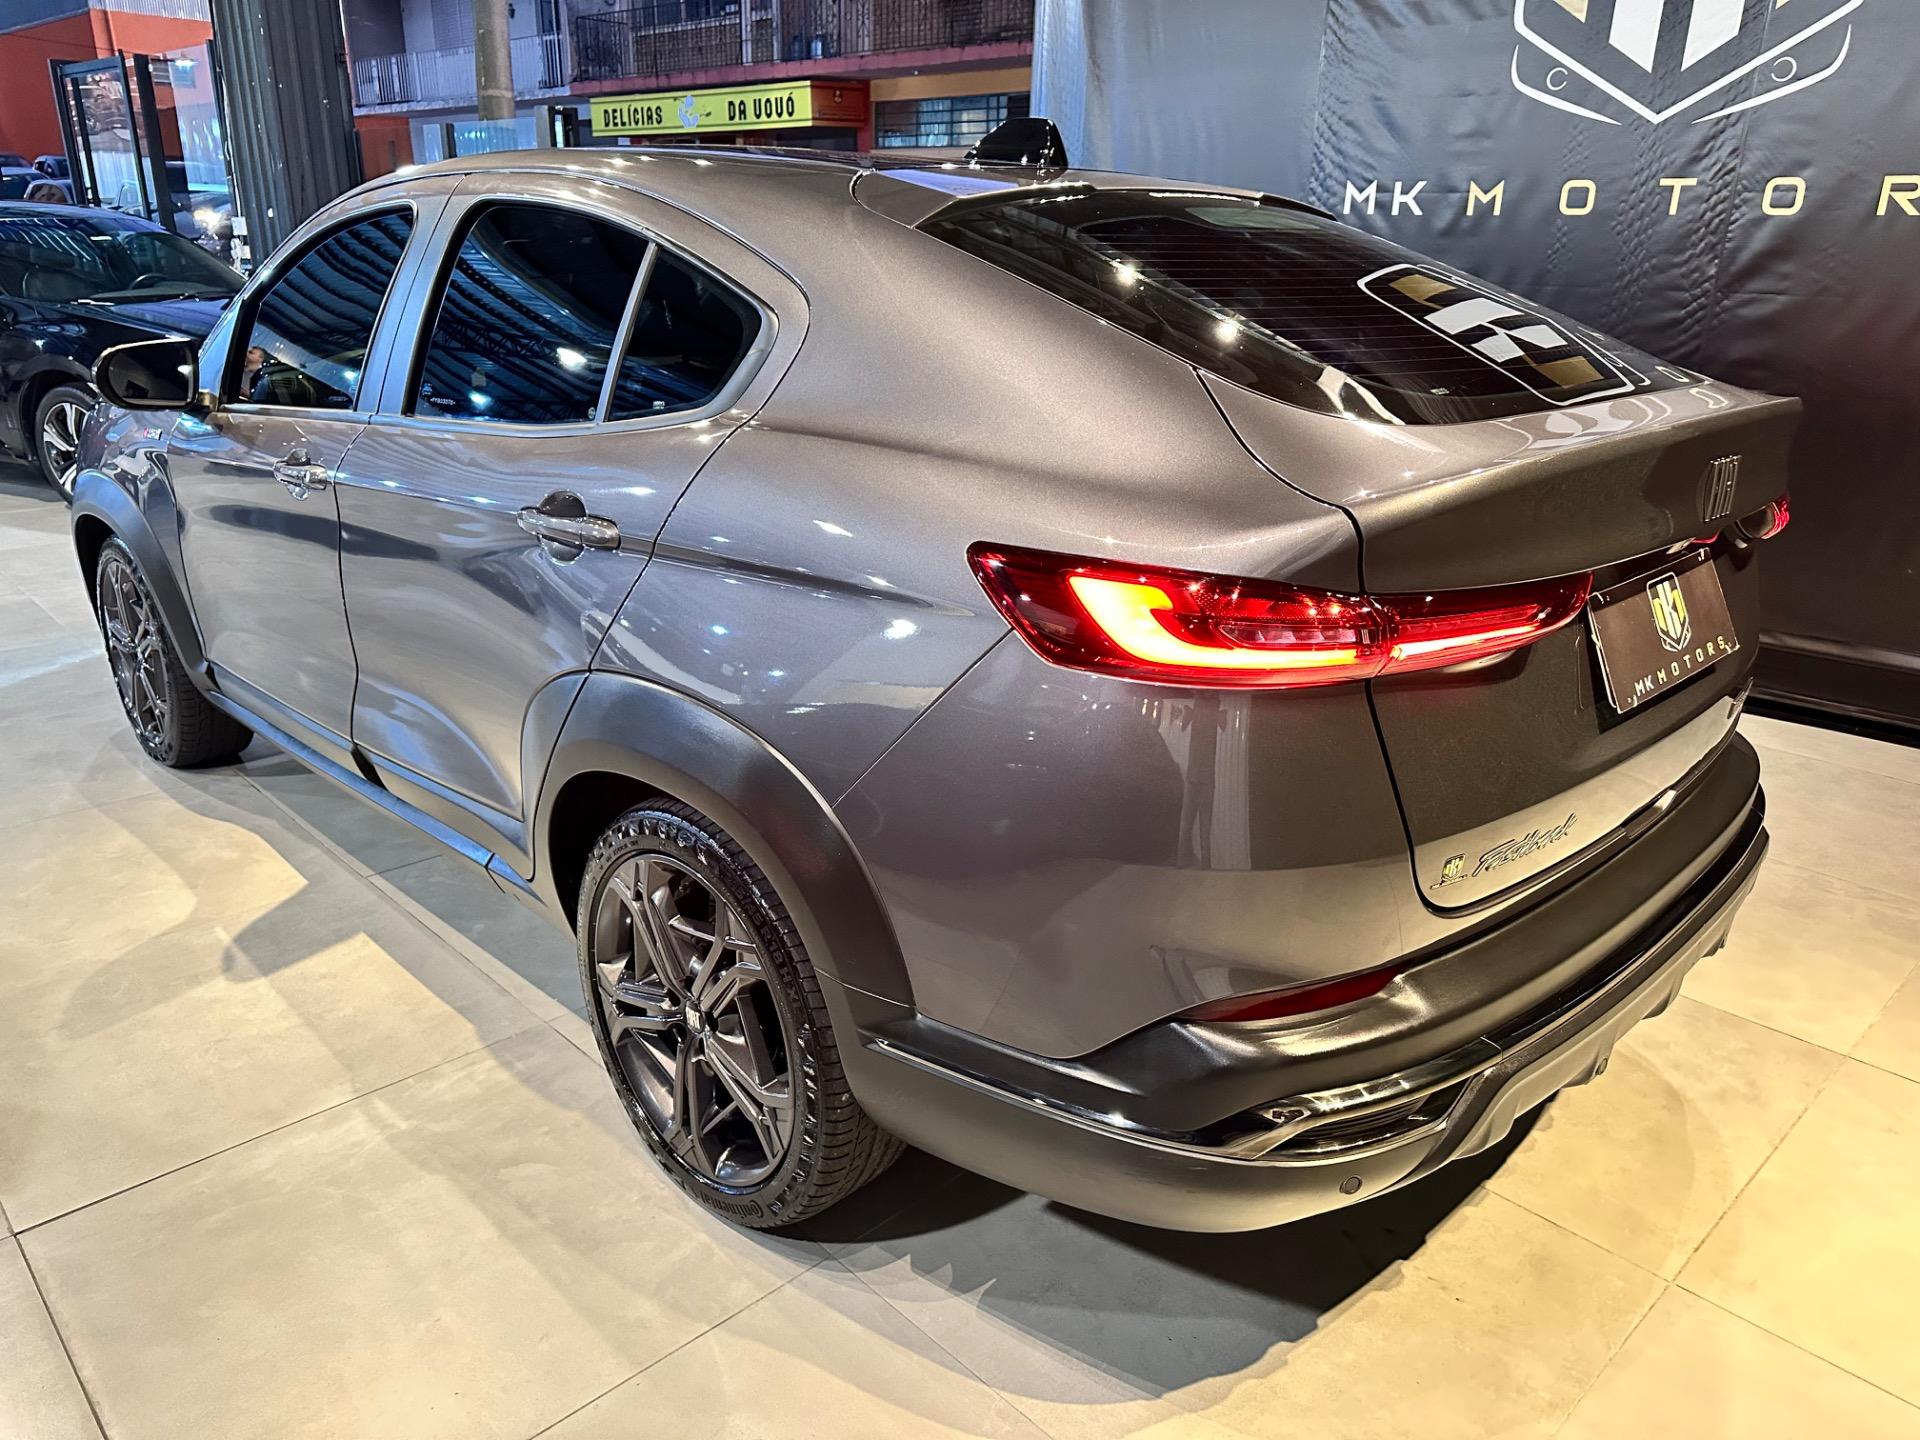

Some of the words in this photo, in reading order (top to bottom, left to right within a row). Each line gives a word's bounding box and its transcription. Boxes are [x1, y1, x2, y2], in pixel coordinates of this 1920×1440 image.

[603, 103, 663, 128] DELÍCIAS
[728, 99, 747, 121] DA
[1343, 179, 1428, 216] MK
[1634, 675, 1654, 696] MK
[1657, 635, 1726, 685] MOTORS
[700, 1191, 764, 1218] Continental
